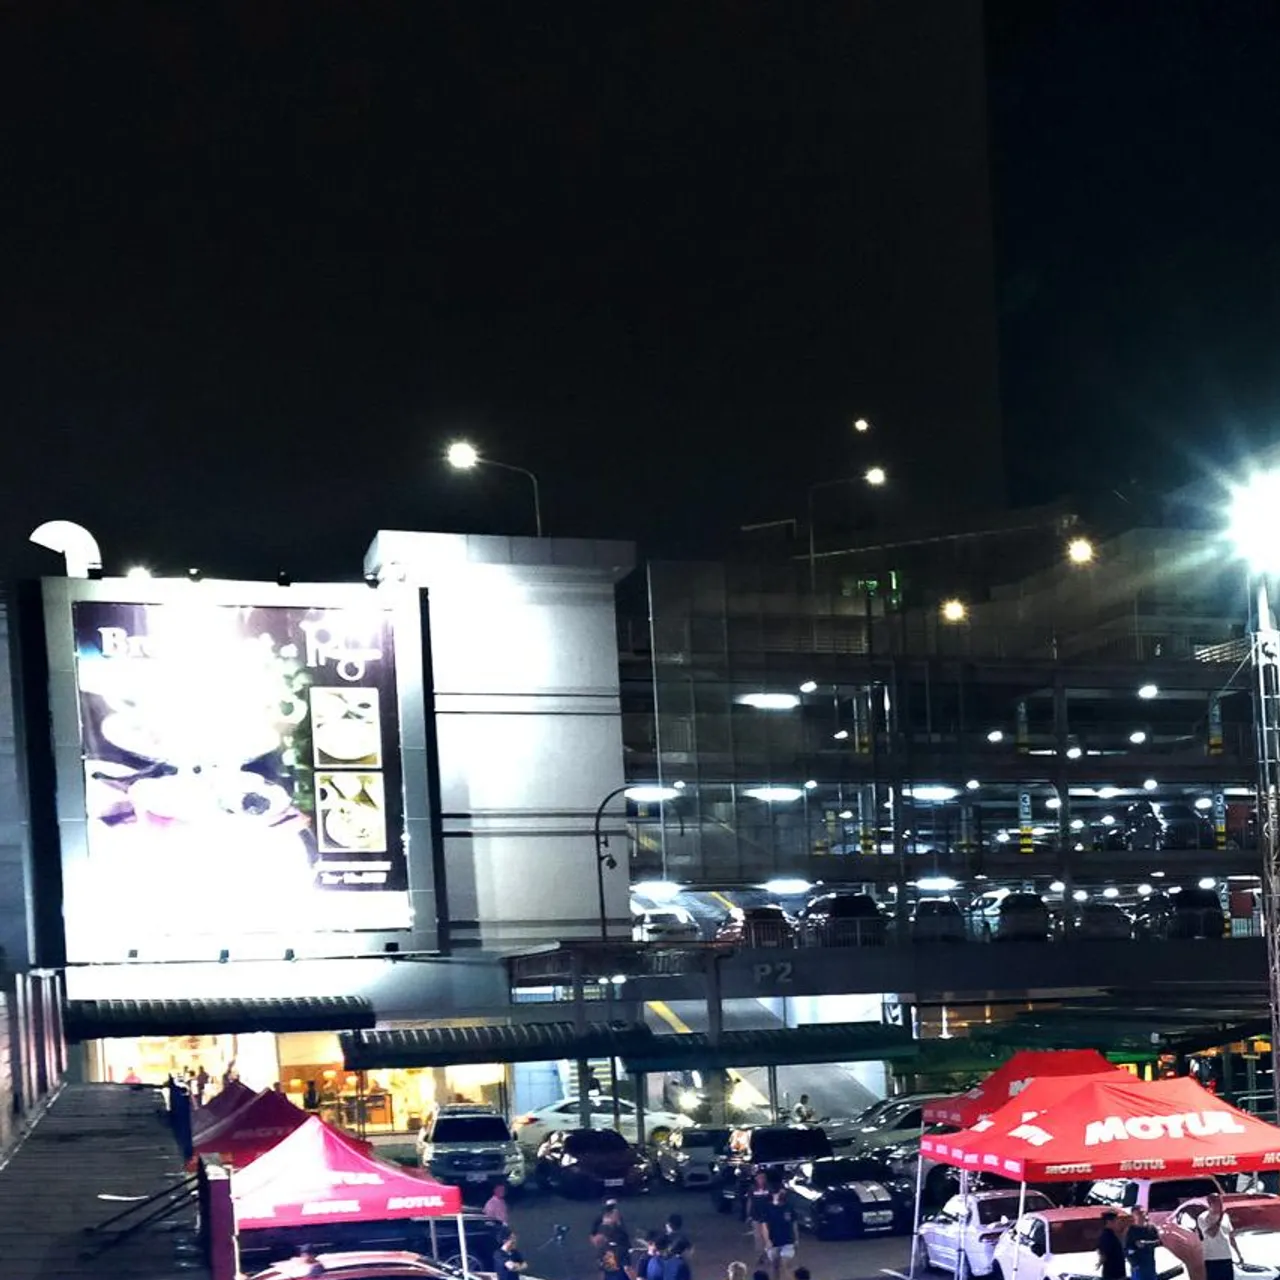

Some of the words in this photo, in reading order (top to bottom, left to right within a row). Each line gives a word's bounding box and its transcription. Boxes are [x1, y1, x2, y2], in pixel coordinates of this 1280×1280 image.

[755, 963, 792, 983] P2
[1084, 1111, 1246, 1146] MOTUL
[1119, 1159, 1166, 1172] MOTUL
[1191, 1155, 1239, 1168] MOTUL
